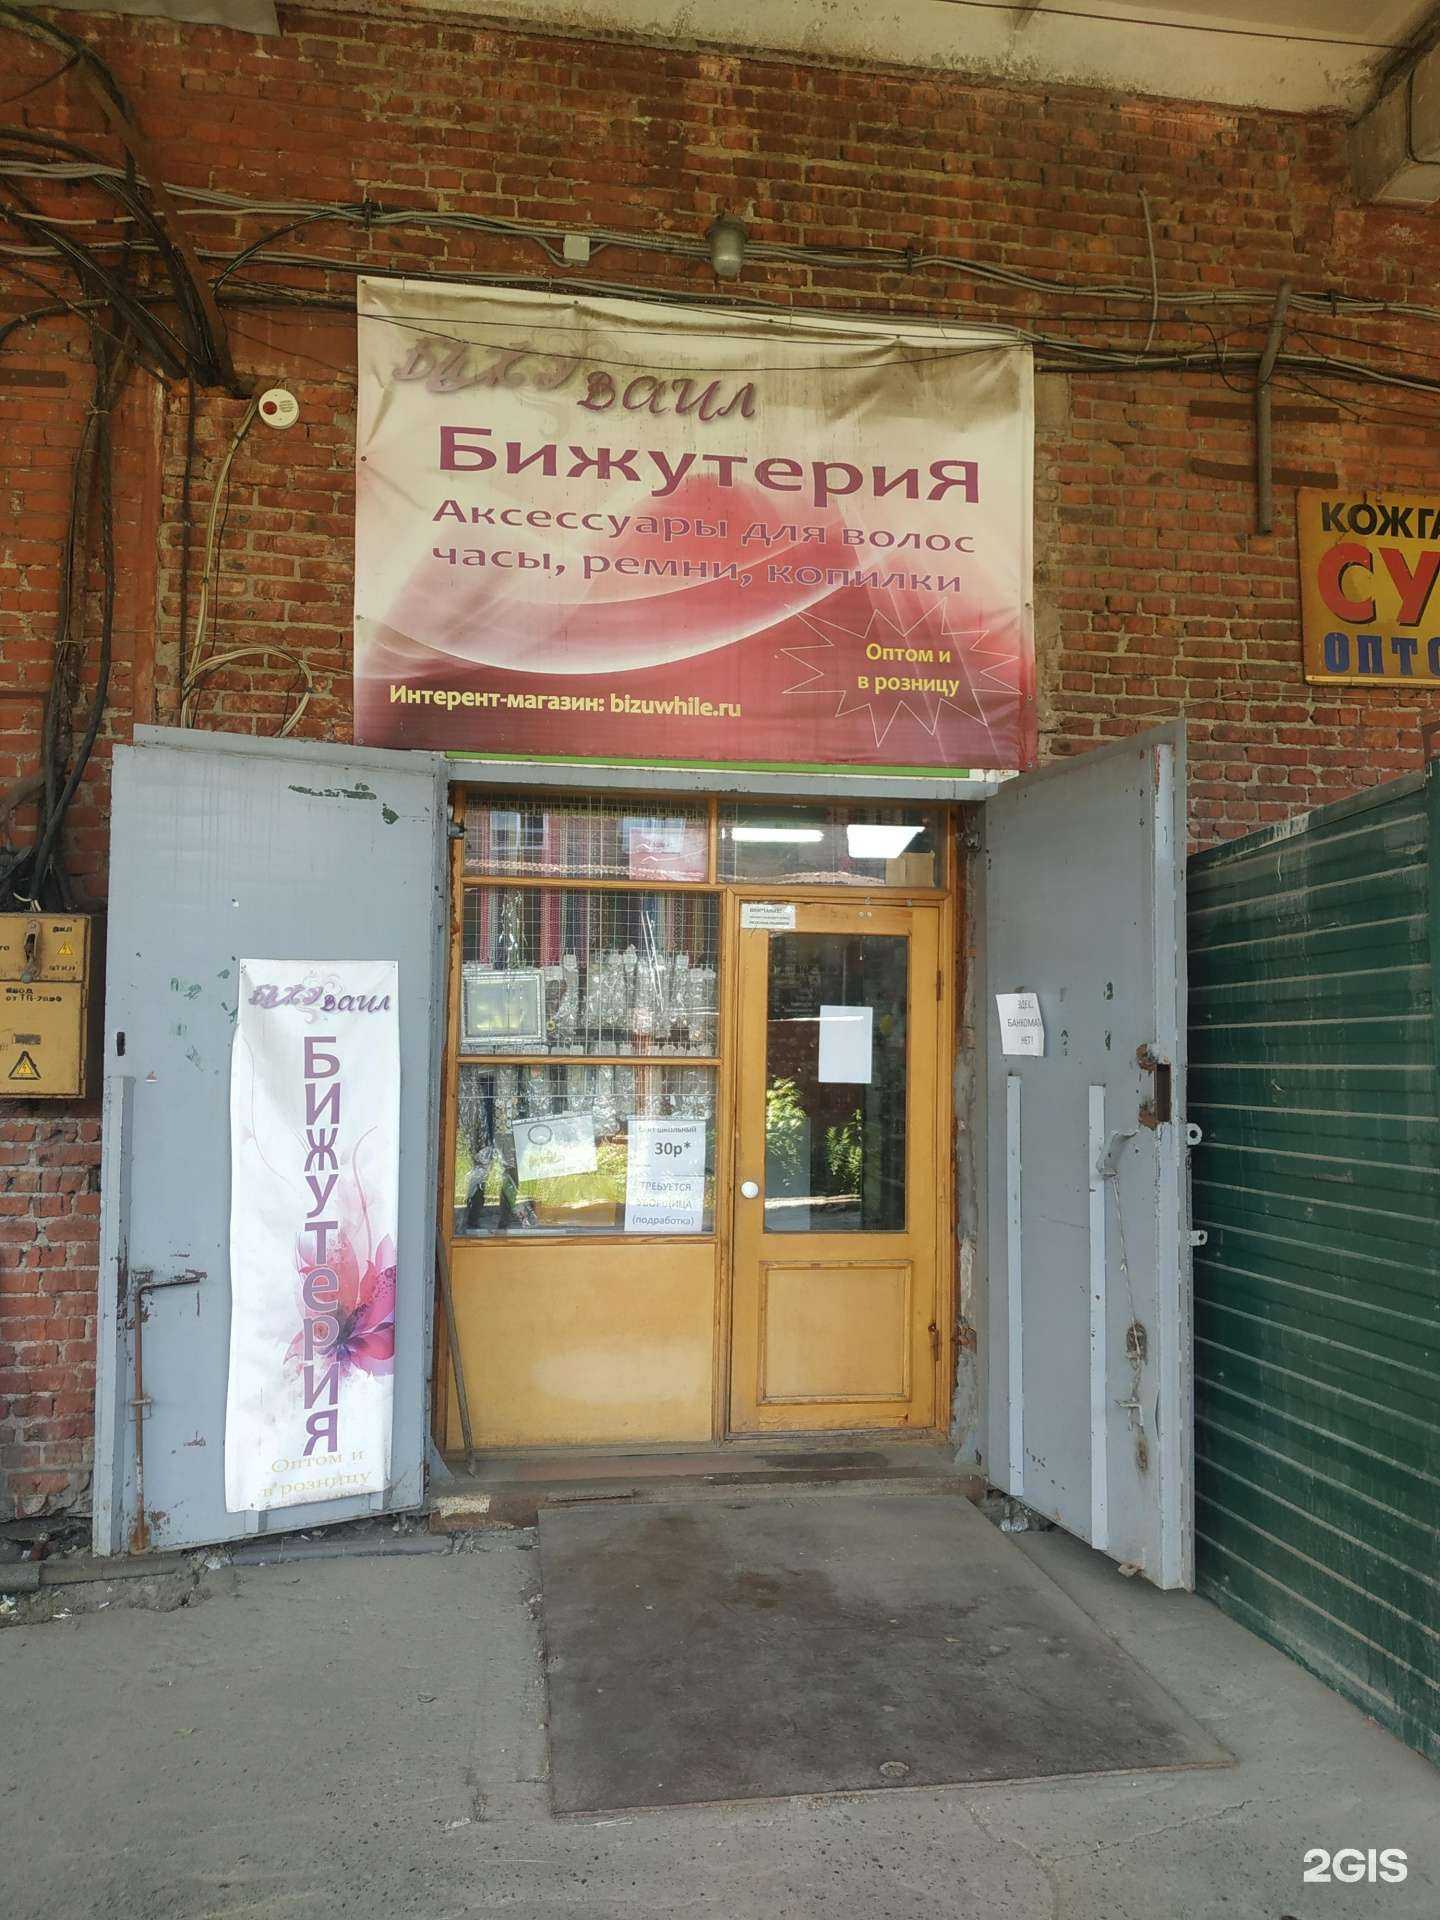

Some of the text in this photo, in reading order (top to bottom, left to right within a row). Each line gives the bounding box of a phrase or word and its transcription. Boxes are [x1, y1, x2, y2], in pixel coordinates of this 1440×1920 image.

[432, 500, 975, 553] Аксессуары для волос
[433, 547, 961, 593] часы, ремни, копилки
[865, 643, 951, 663] Оптом и
[857, 676, 960, 697] в розницу
[389, 685, 742, 718] Интерент-магазин: bizuwhile.ru
[632, 1215, 694, 1226] (подработка)
